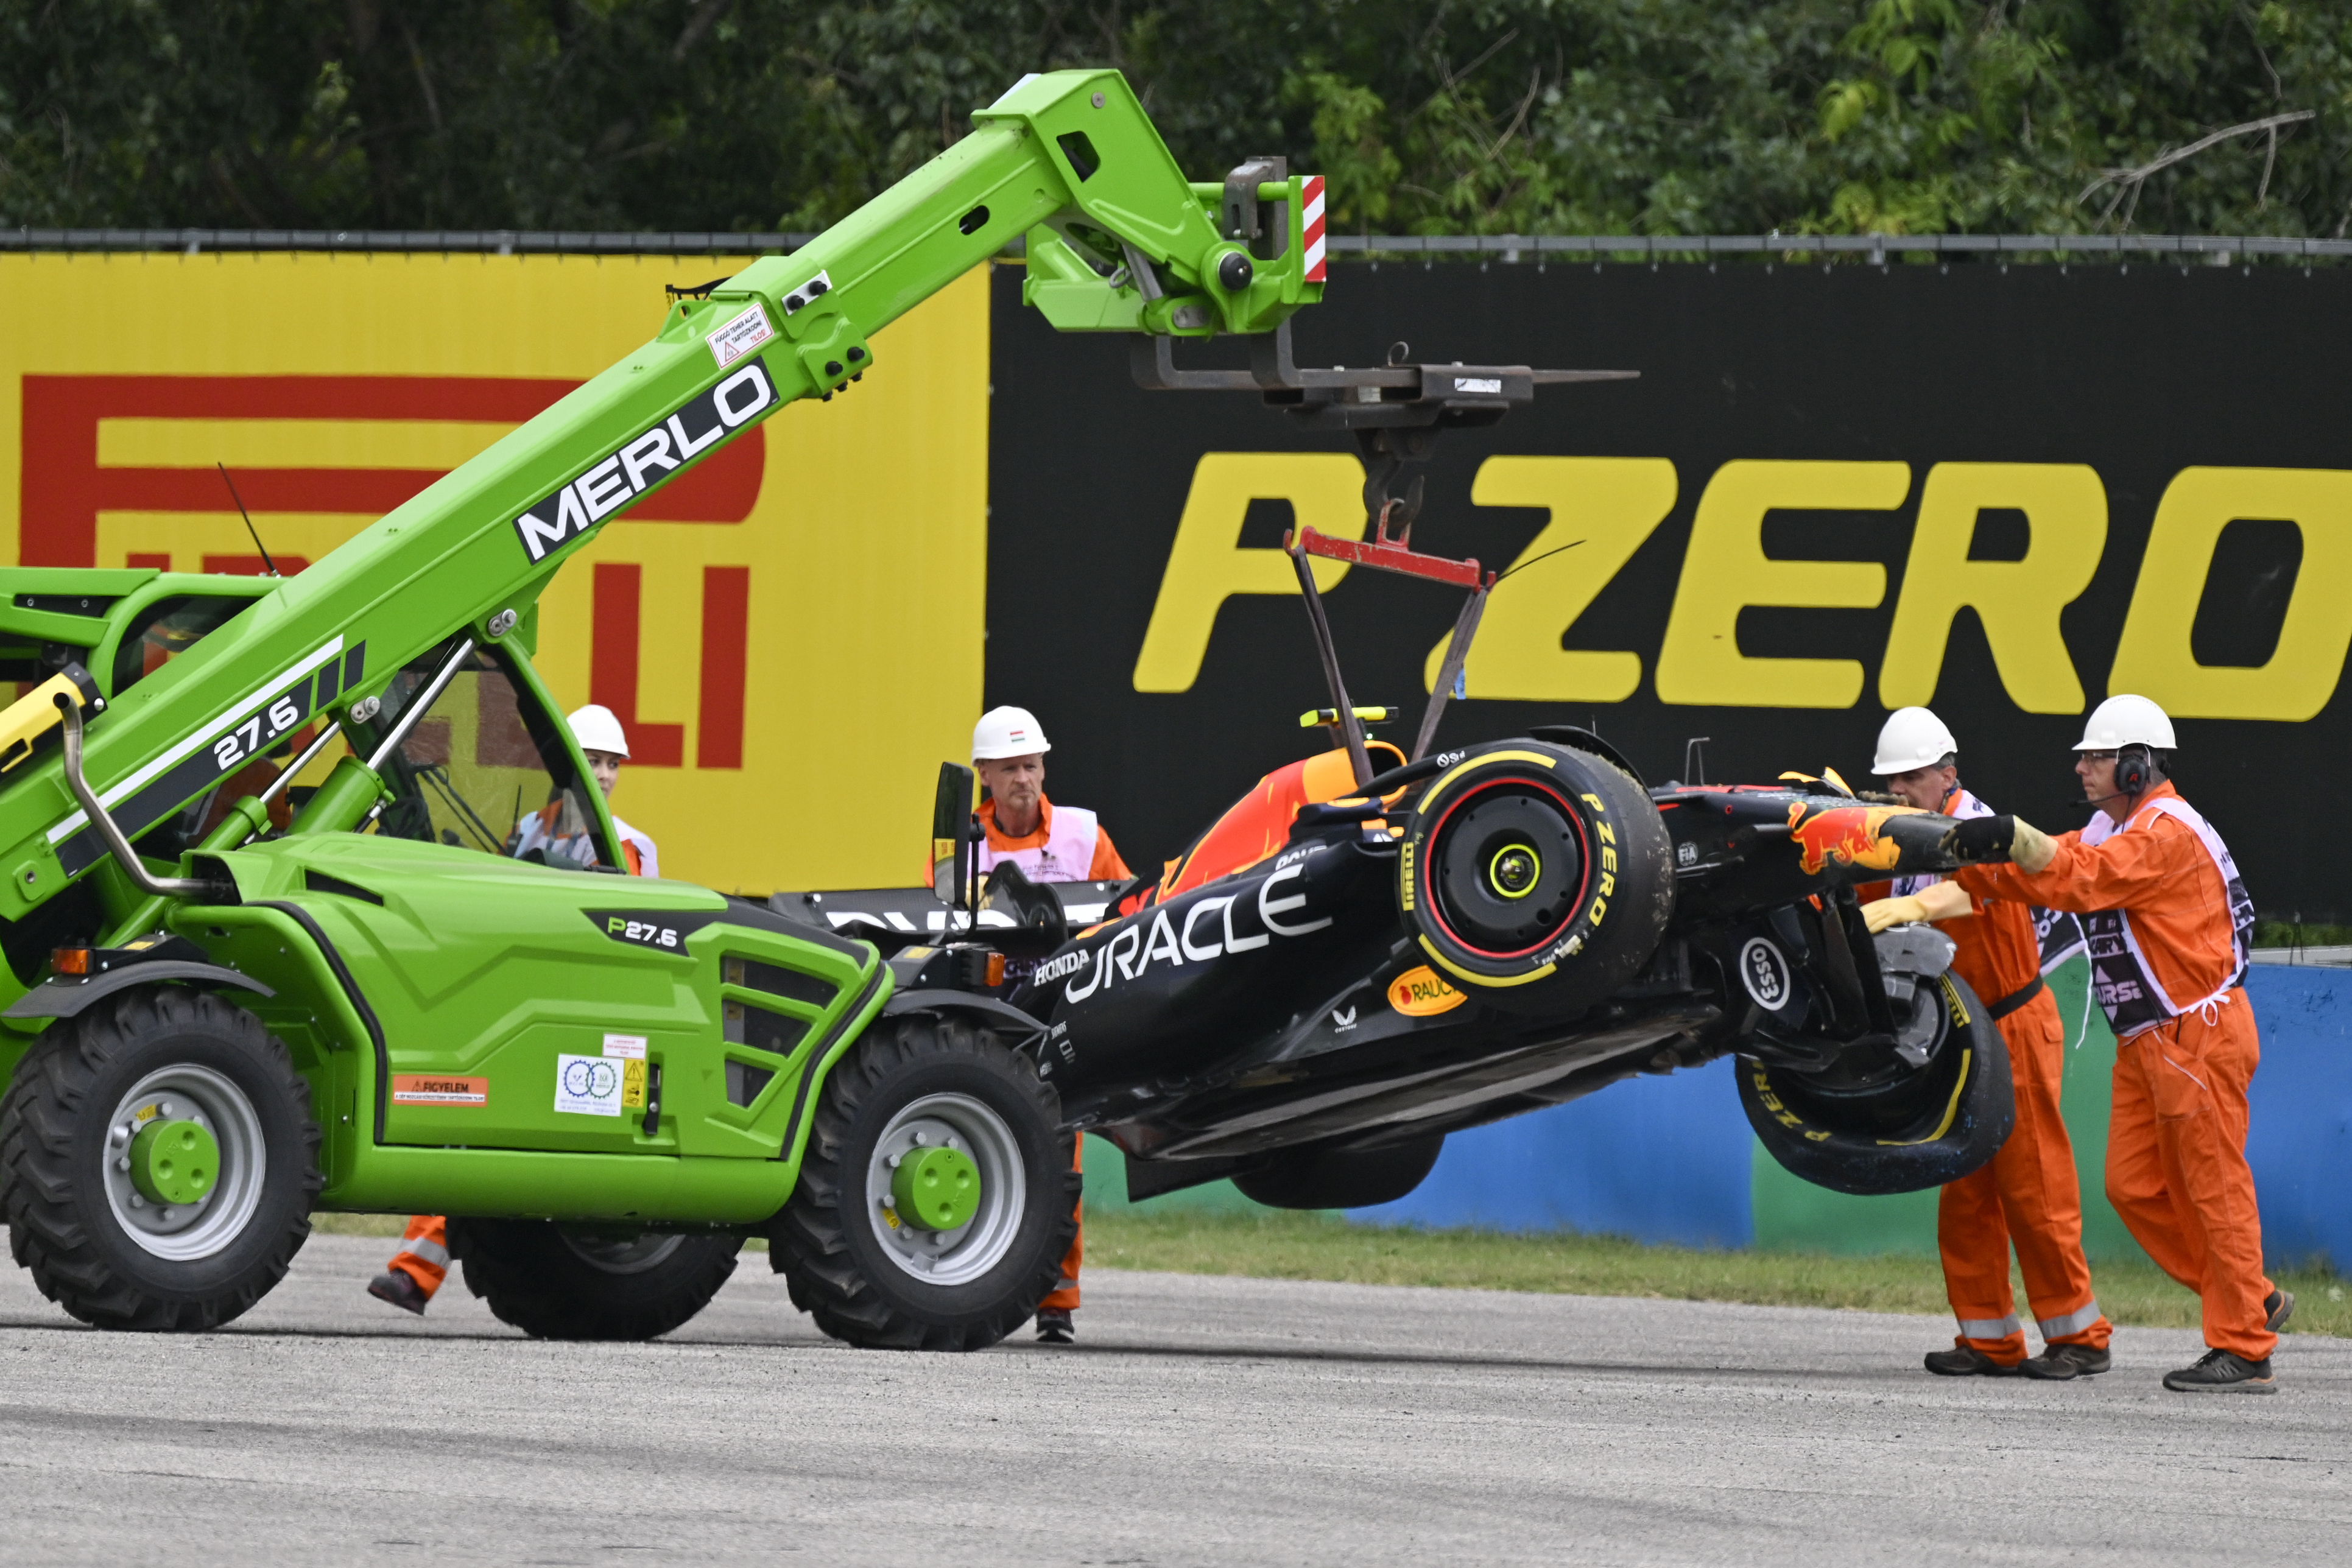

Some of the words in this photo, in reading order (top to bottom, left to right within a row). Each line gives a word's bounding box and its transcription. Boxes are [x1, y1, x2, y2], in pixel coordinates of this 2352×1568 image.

[730, 320, 744, 334] TEHER
[744, 311, 758, 325] ALATT
[517, 365, 771, 561] MERLO
[1133, 452, 1368, 693] P
[1424, 454, 2352, 722] ZERO
[213, 695, 298, 771] 27.6
[1580, 793, 1605, 812] P
[1401, 842, 1415, 911] PIRELLI
[1589, 820, 1618, 927] ZERO
[607, 916, 677, 947] P27.6
[1033, 948, 1090, 988] HONDA
[1412, 979, 1456, 1001] RAUC
[1752, 946, 1780, 1000] ESSO
[423, 1081, 470, 1094] FIGYELEM
